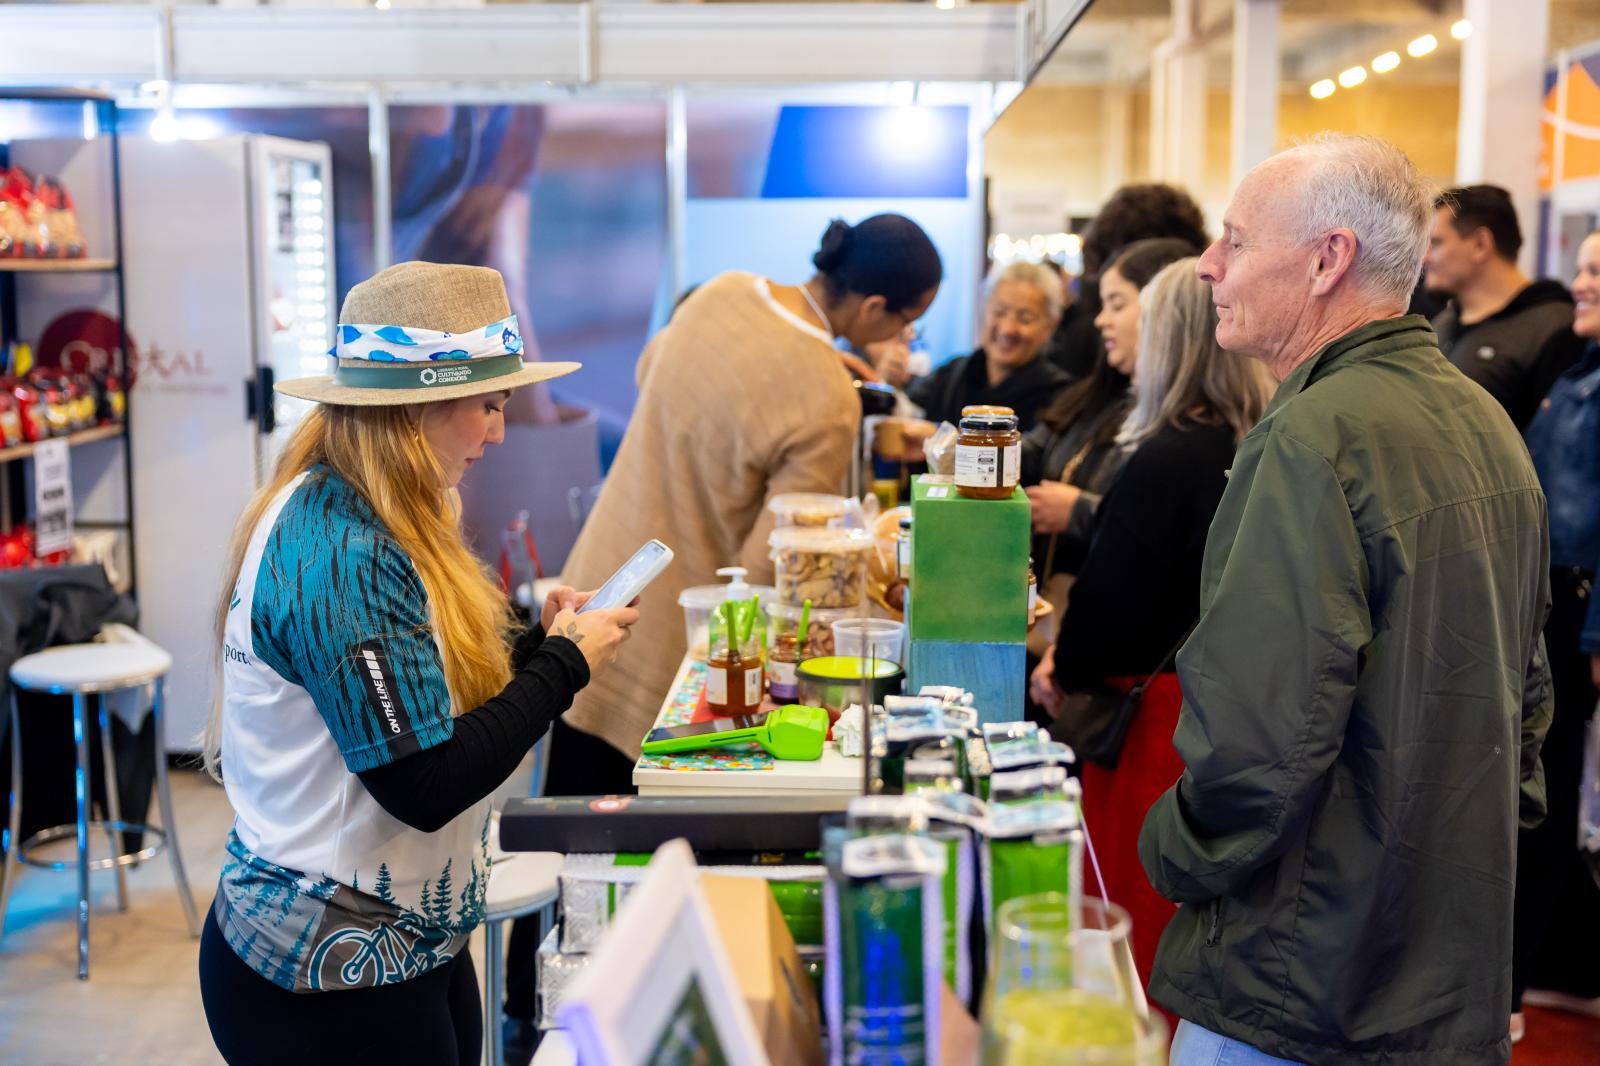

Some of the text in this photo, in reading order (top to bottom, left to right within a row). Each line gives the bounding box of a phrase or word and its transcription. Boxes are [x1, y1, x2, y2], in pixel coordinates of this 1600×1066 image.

[437, 369, 472, 377] CULTIVANDO
[381, 701, 395, 718] THE
[388, 718, 401, 734] ON
